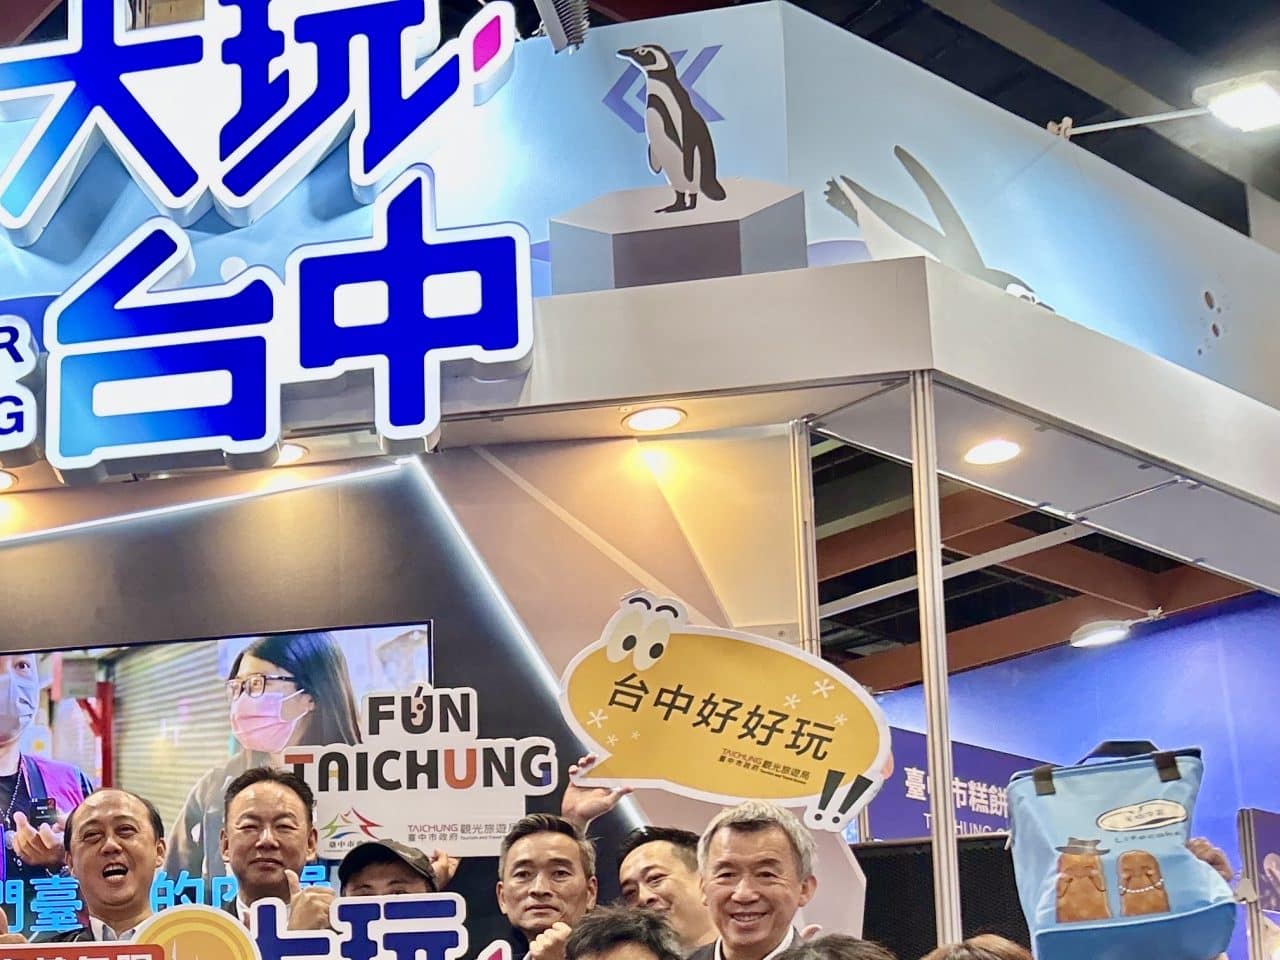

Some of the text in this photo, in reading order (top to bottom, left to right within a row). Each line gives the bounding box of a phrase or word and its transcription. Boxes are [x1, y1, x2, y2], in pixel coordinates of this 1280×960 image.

[57, 177, 521, 458] 台中
[608, 673, 836, 761] 台中好好玩
[285, 745, 552, 792] TAICHUNG
